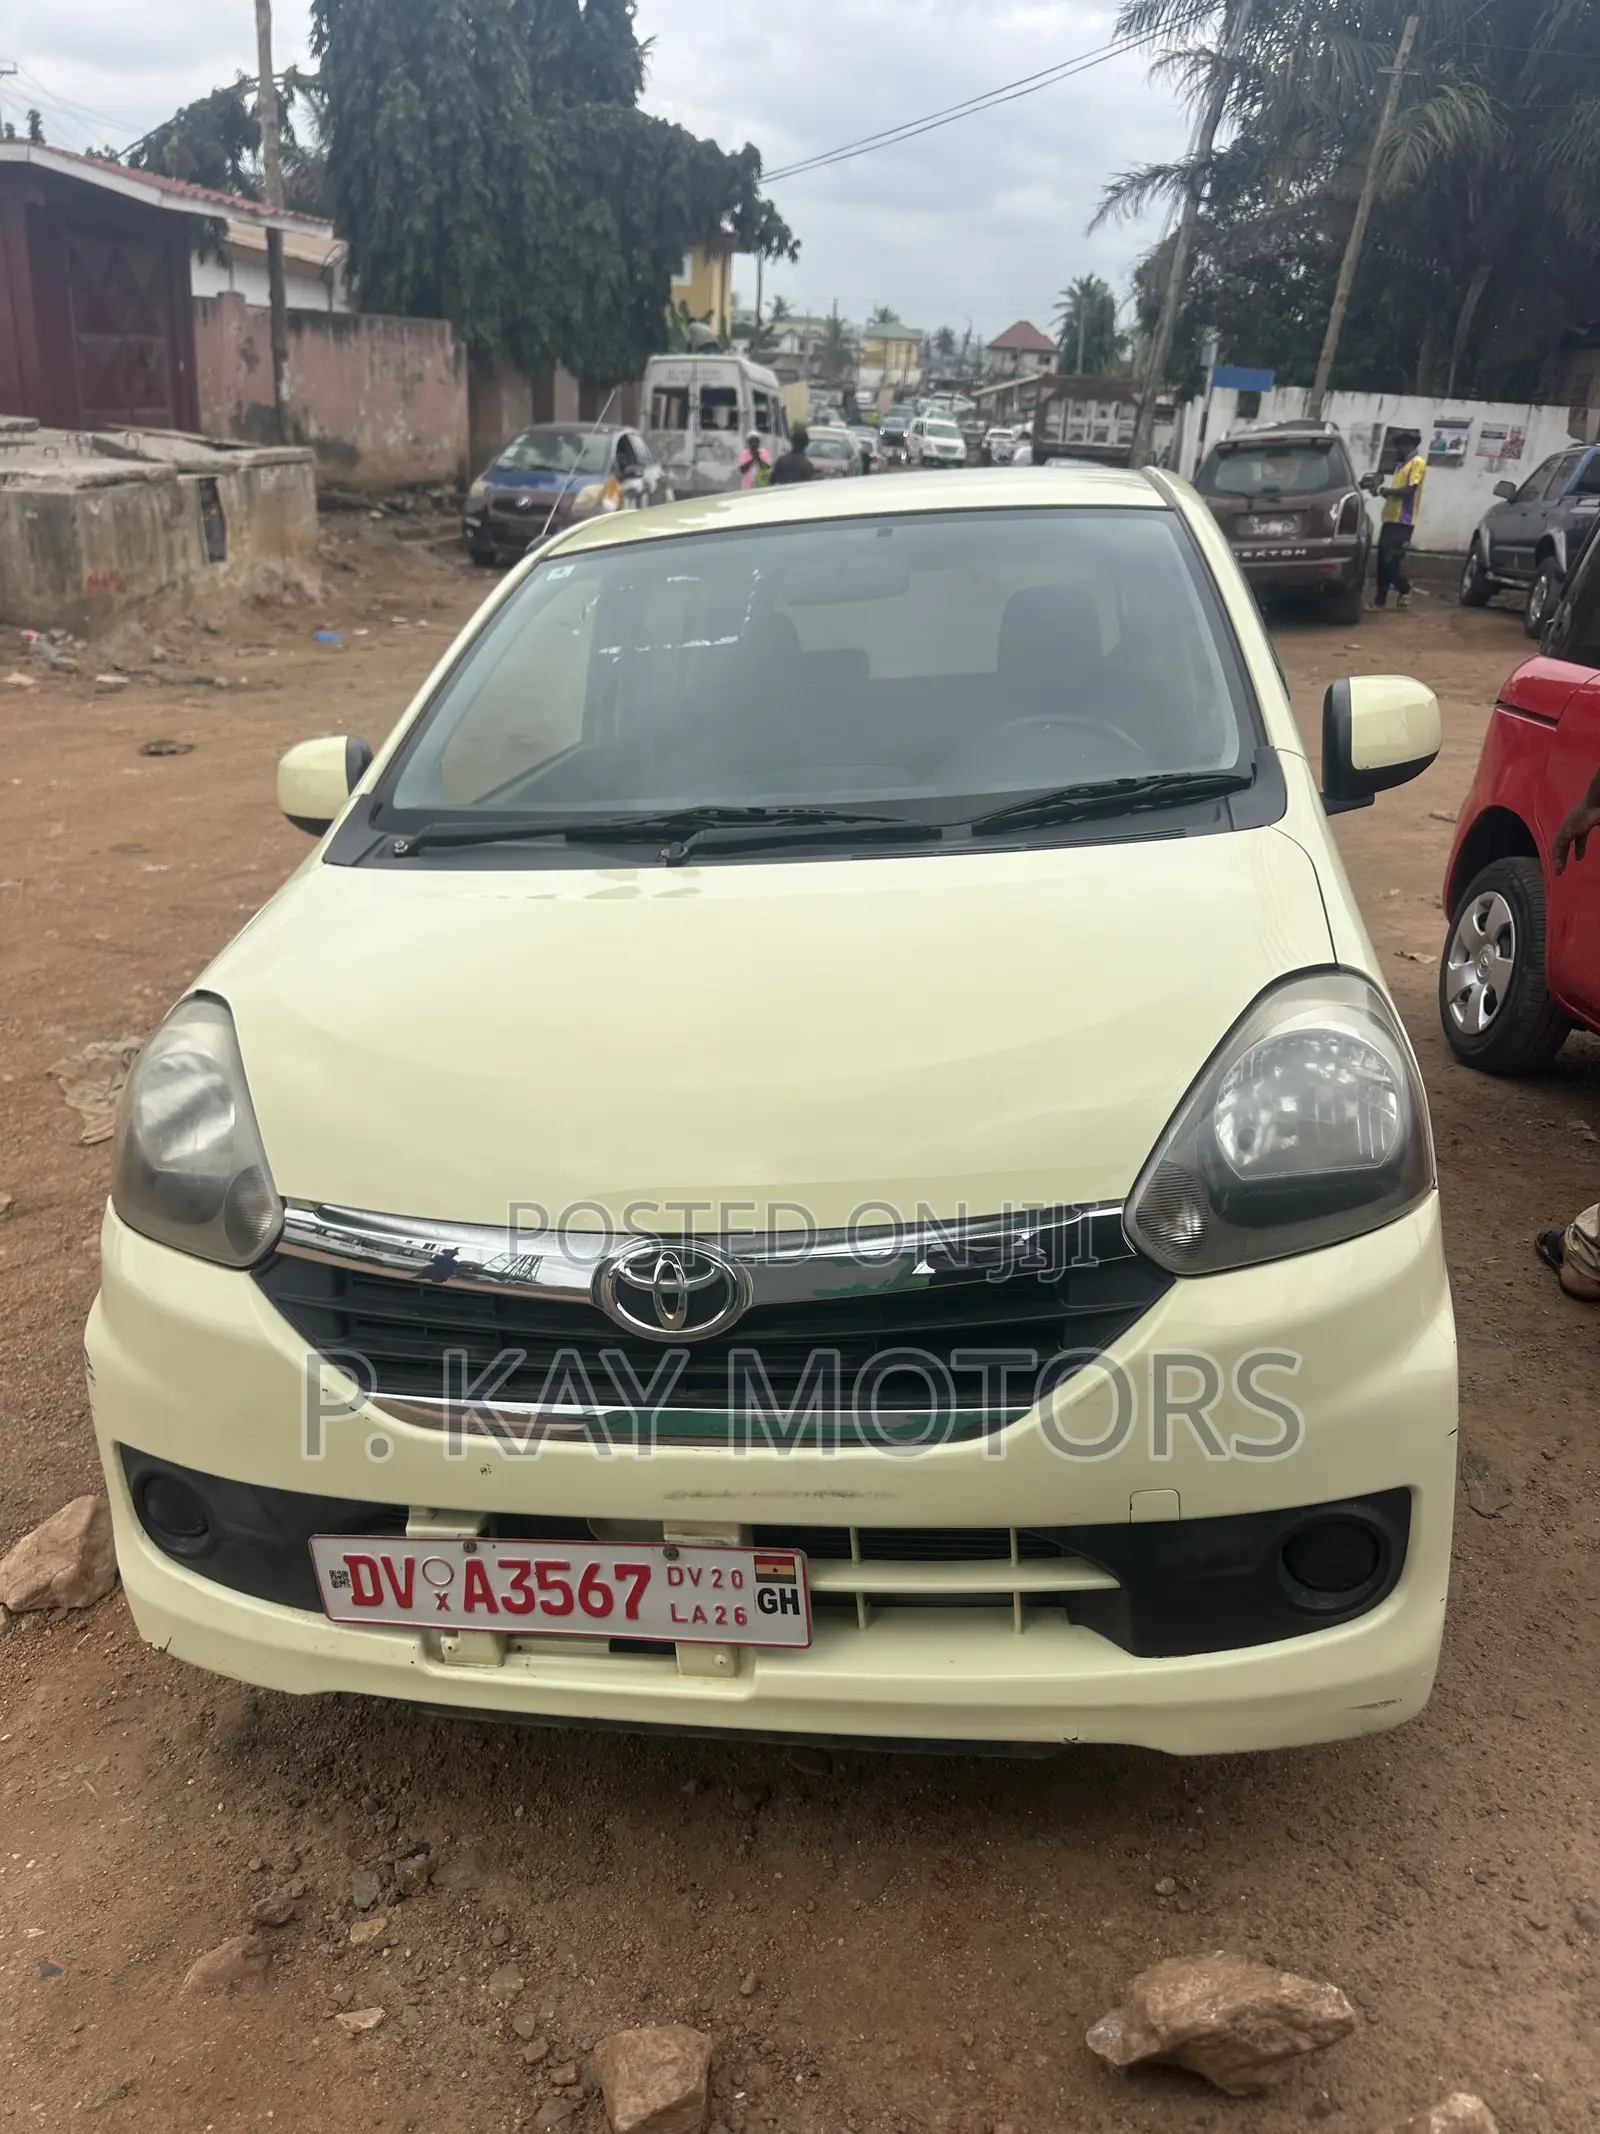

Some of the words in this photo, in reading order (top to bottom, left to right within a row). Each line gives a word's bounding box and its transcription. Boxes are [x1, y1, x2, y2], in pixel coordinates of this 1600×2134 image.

[342, 1553, 415, 1608] DV
[463, 1558, 652, 1620] A3567
[669, 1600, 748, 1626] LA26
[757, 1587, 801, 1616] GH
